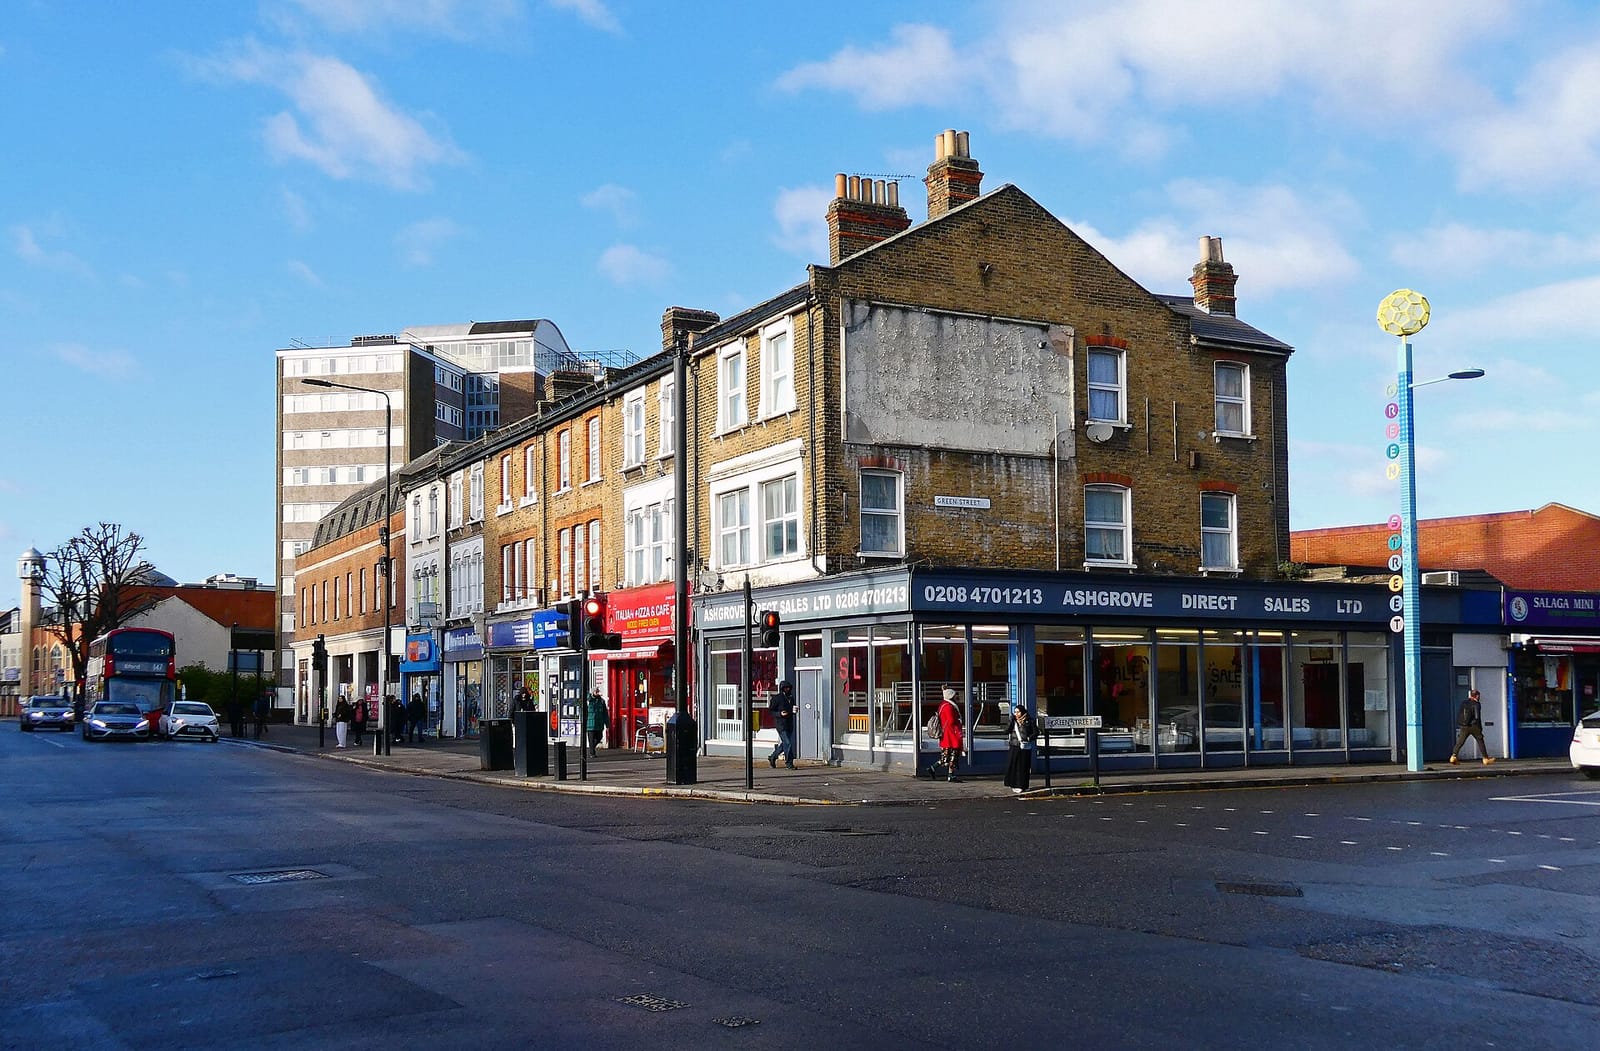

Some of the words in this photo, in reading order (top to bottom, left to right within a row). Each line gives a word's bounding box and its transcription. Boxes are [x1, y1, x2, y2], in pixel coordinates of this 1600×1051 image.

[1388, 515, 1403, 632] STREET
[704, 604, 745, 622] ASHGROVE
[780, 598, 808, 614] SALES
[814, 595, 831, 611] LTD
[836, 592, 859, 609] 0208
[861, 587, 906, 605] 4701213
[924, 585, 968, 603] 0208
[970, 587, 1043, 604] 4701213
[1062, 590, 1153, 608] ASHGROVE
[1181, 594, 1238, 611] DIRECT
[1264, 597, 1311, 613] SALES
[1336, 600, 1363, 614] LTD
[1533, 597, 1569, 609] SALAGA
[1573, 598, 1594, 609] MINI
[1050, 718, 1070, 727] GREEN
[1071, 718, 1093, 727] STREET
